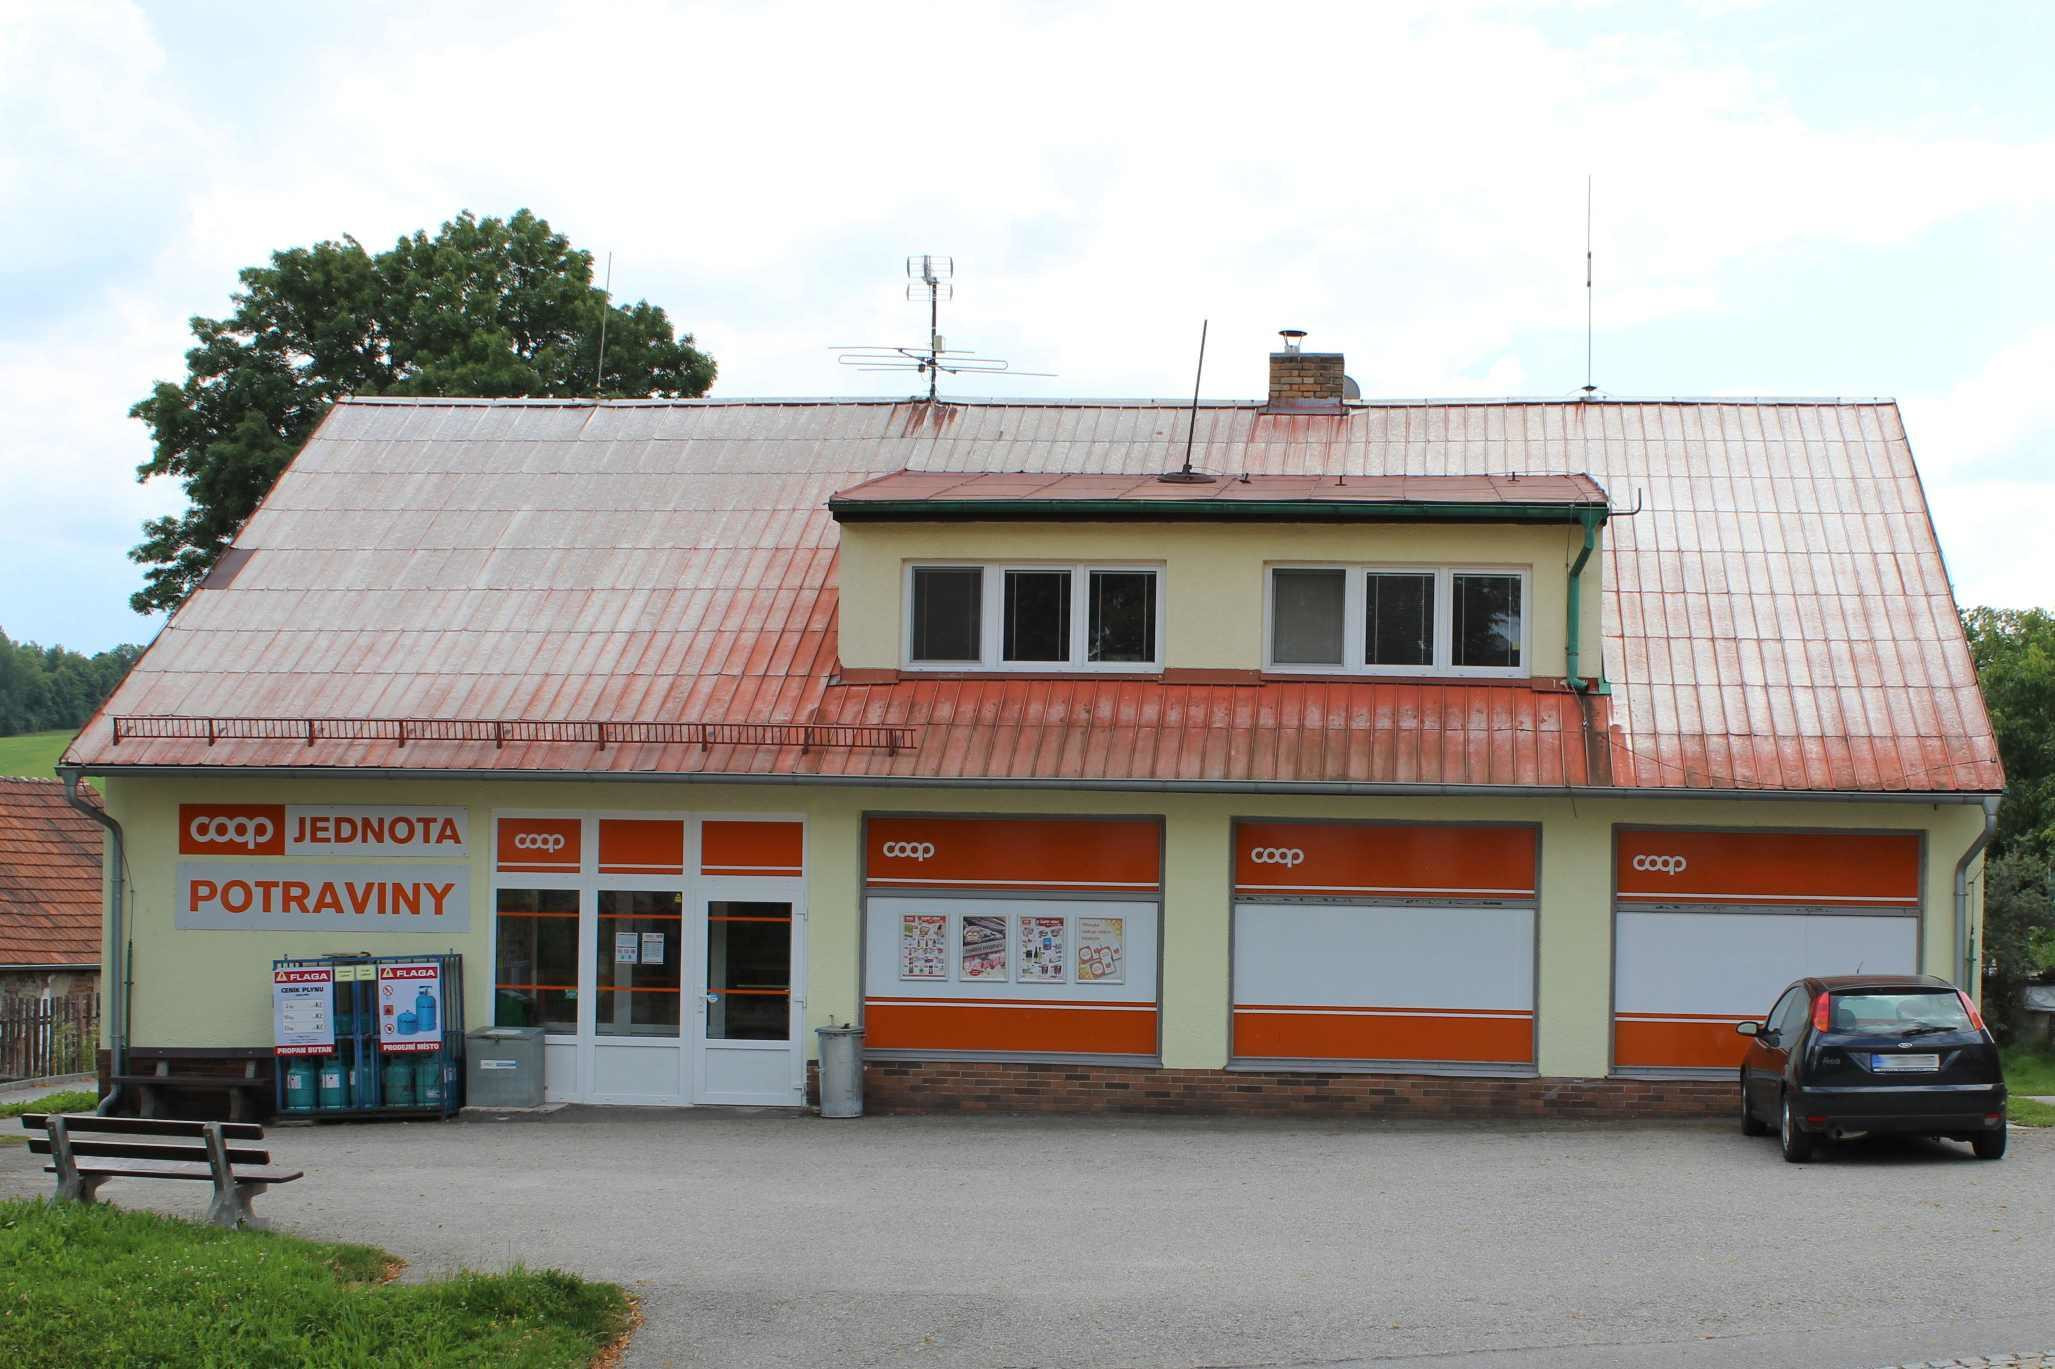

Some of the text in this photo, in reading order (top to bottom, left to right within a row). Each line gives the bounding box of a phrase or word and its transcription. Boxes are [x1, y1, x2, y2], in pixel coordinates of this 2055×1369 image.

[190, 815, 462, 849] coop JEDNOTA
[515, 833, 565, 853] coop
[883, 841, 935, 862] coop
[1251, 847, 1304, 868] coop
[1633, 855, 1687, 875] coop
[188, 880, 455, 915] POTRAVINY
[290, 973, 329, 981] FLAGA
[396, 969, 435, 977] FLAGA
